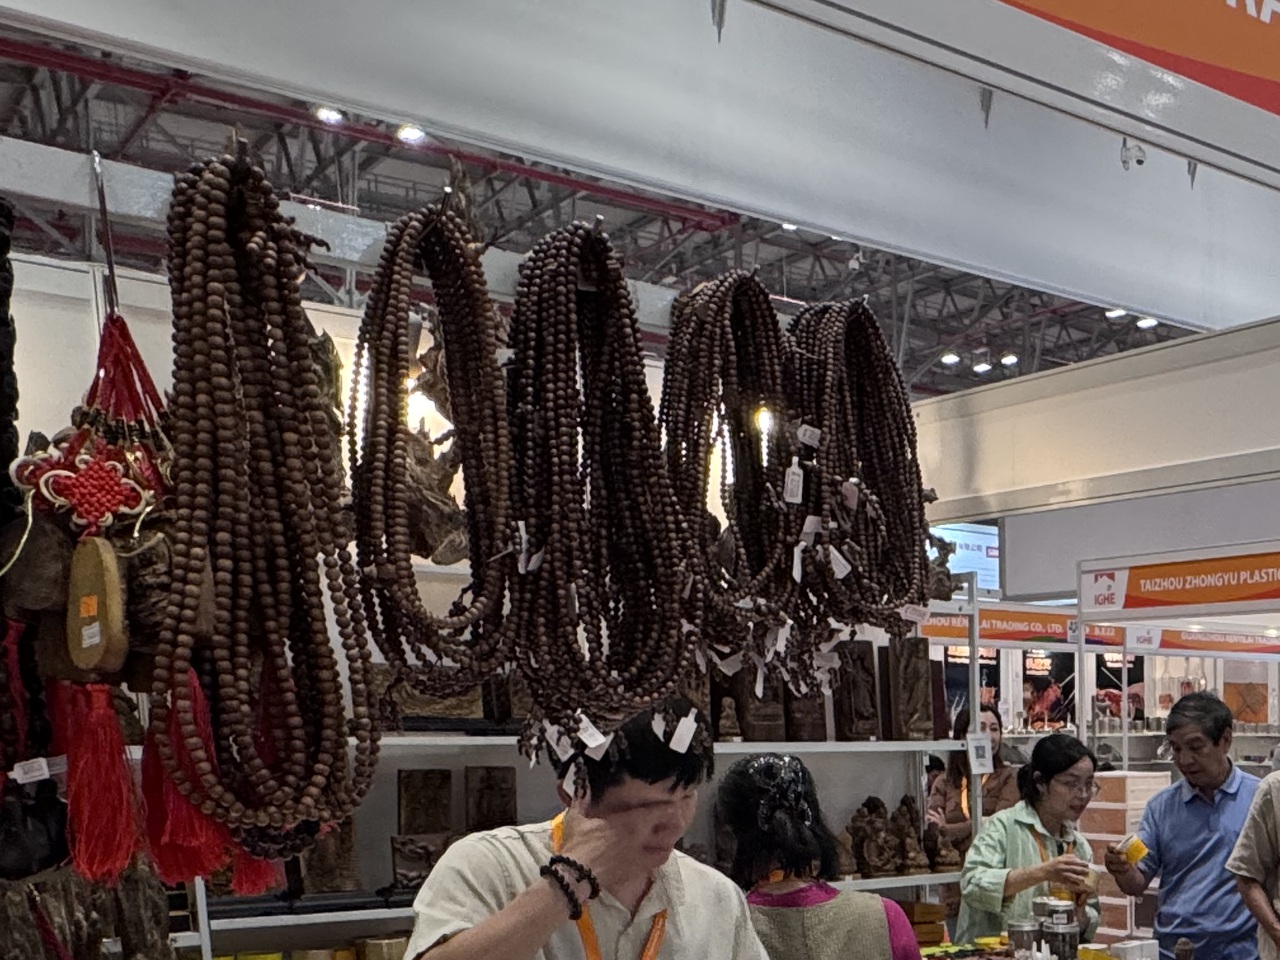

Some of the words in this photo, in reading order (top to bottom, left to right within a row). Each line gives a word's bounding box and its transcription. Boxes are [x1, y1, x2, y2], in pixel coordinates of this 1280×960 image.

[1140, 578, 1183, 592] TAIZHOU
[1185, 572, 1238, 588] ZHONGYU
[1094, 593, 1116, 605] IGHE
